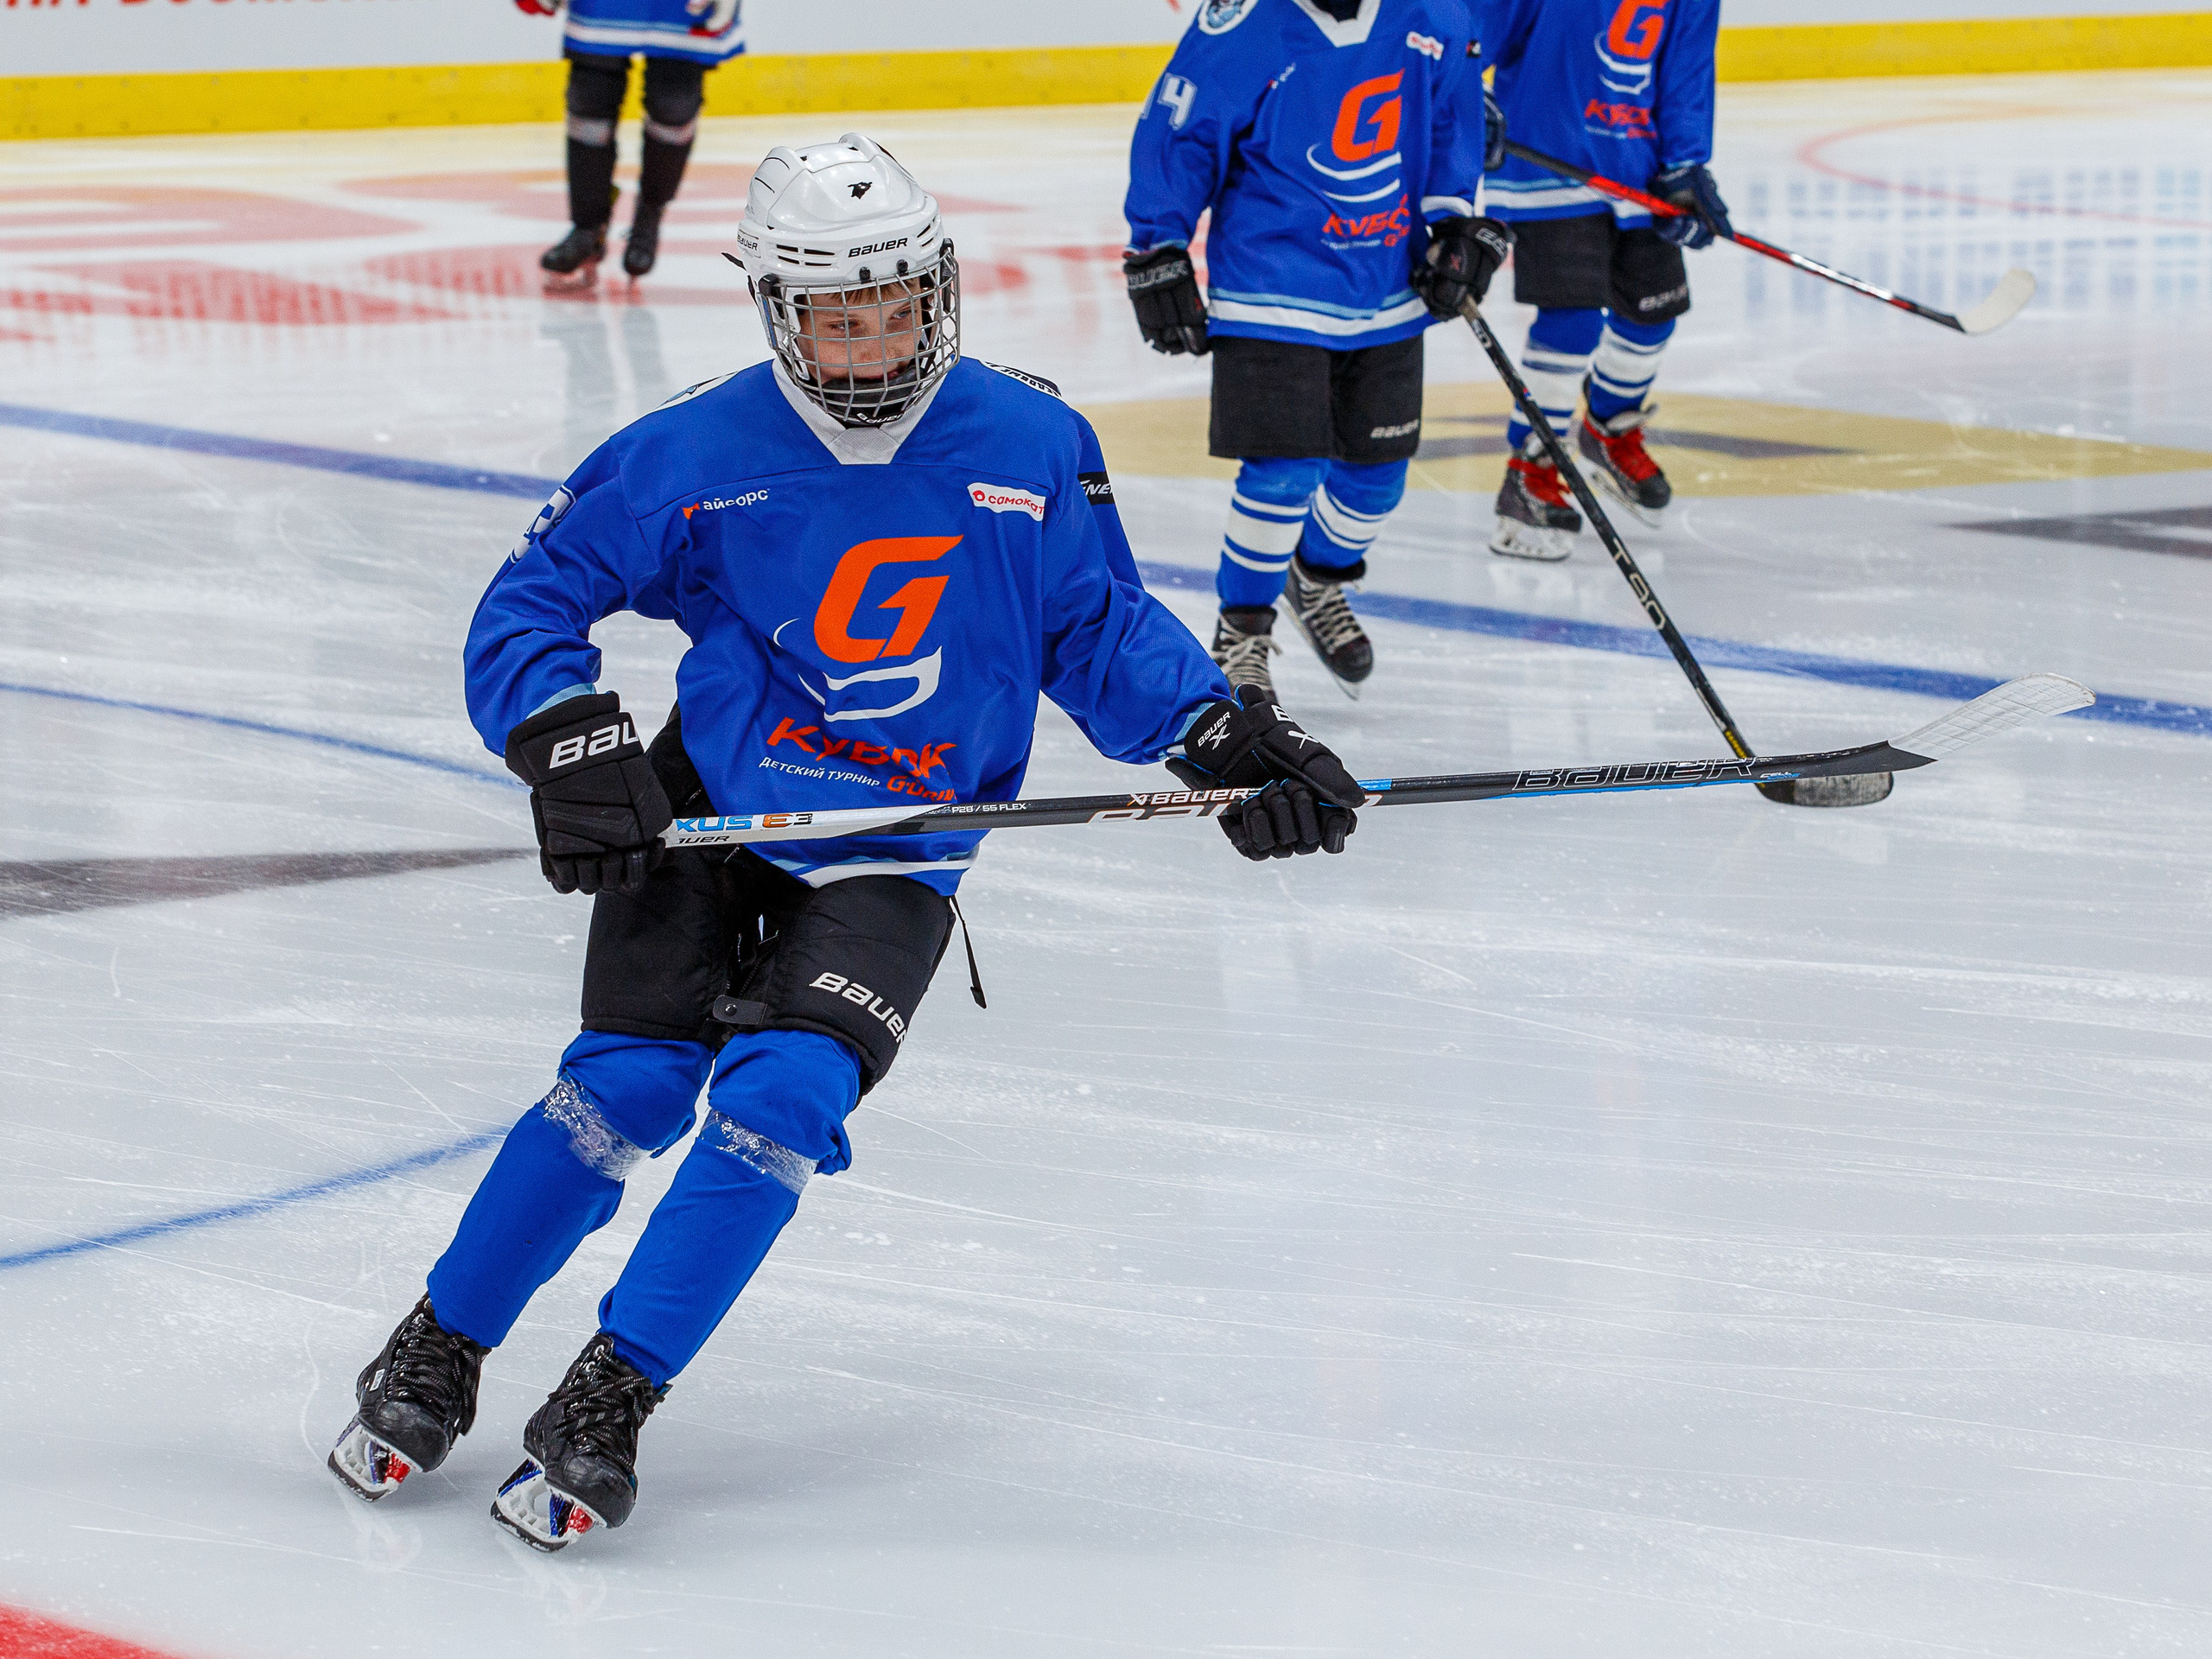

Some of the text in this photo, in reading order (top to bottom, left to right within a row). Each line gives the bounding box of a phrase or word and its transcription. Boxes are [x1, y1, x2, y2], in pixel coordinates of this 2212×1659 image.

[1140, 72, 1198, 130] 4
[848, 237, 908, 258] BAUER
[702, 488, 769, 512] айсорс
[1198, 711, 1231, 747] BAUER
[549, 721, 639, 769] BAU
[999, 803, 1027, 811] FLEX
[1150, 787, 1251, 805] BAUER
[676, 816, 753, 833] XUS
